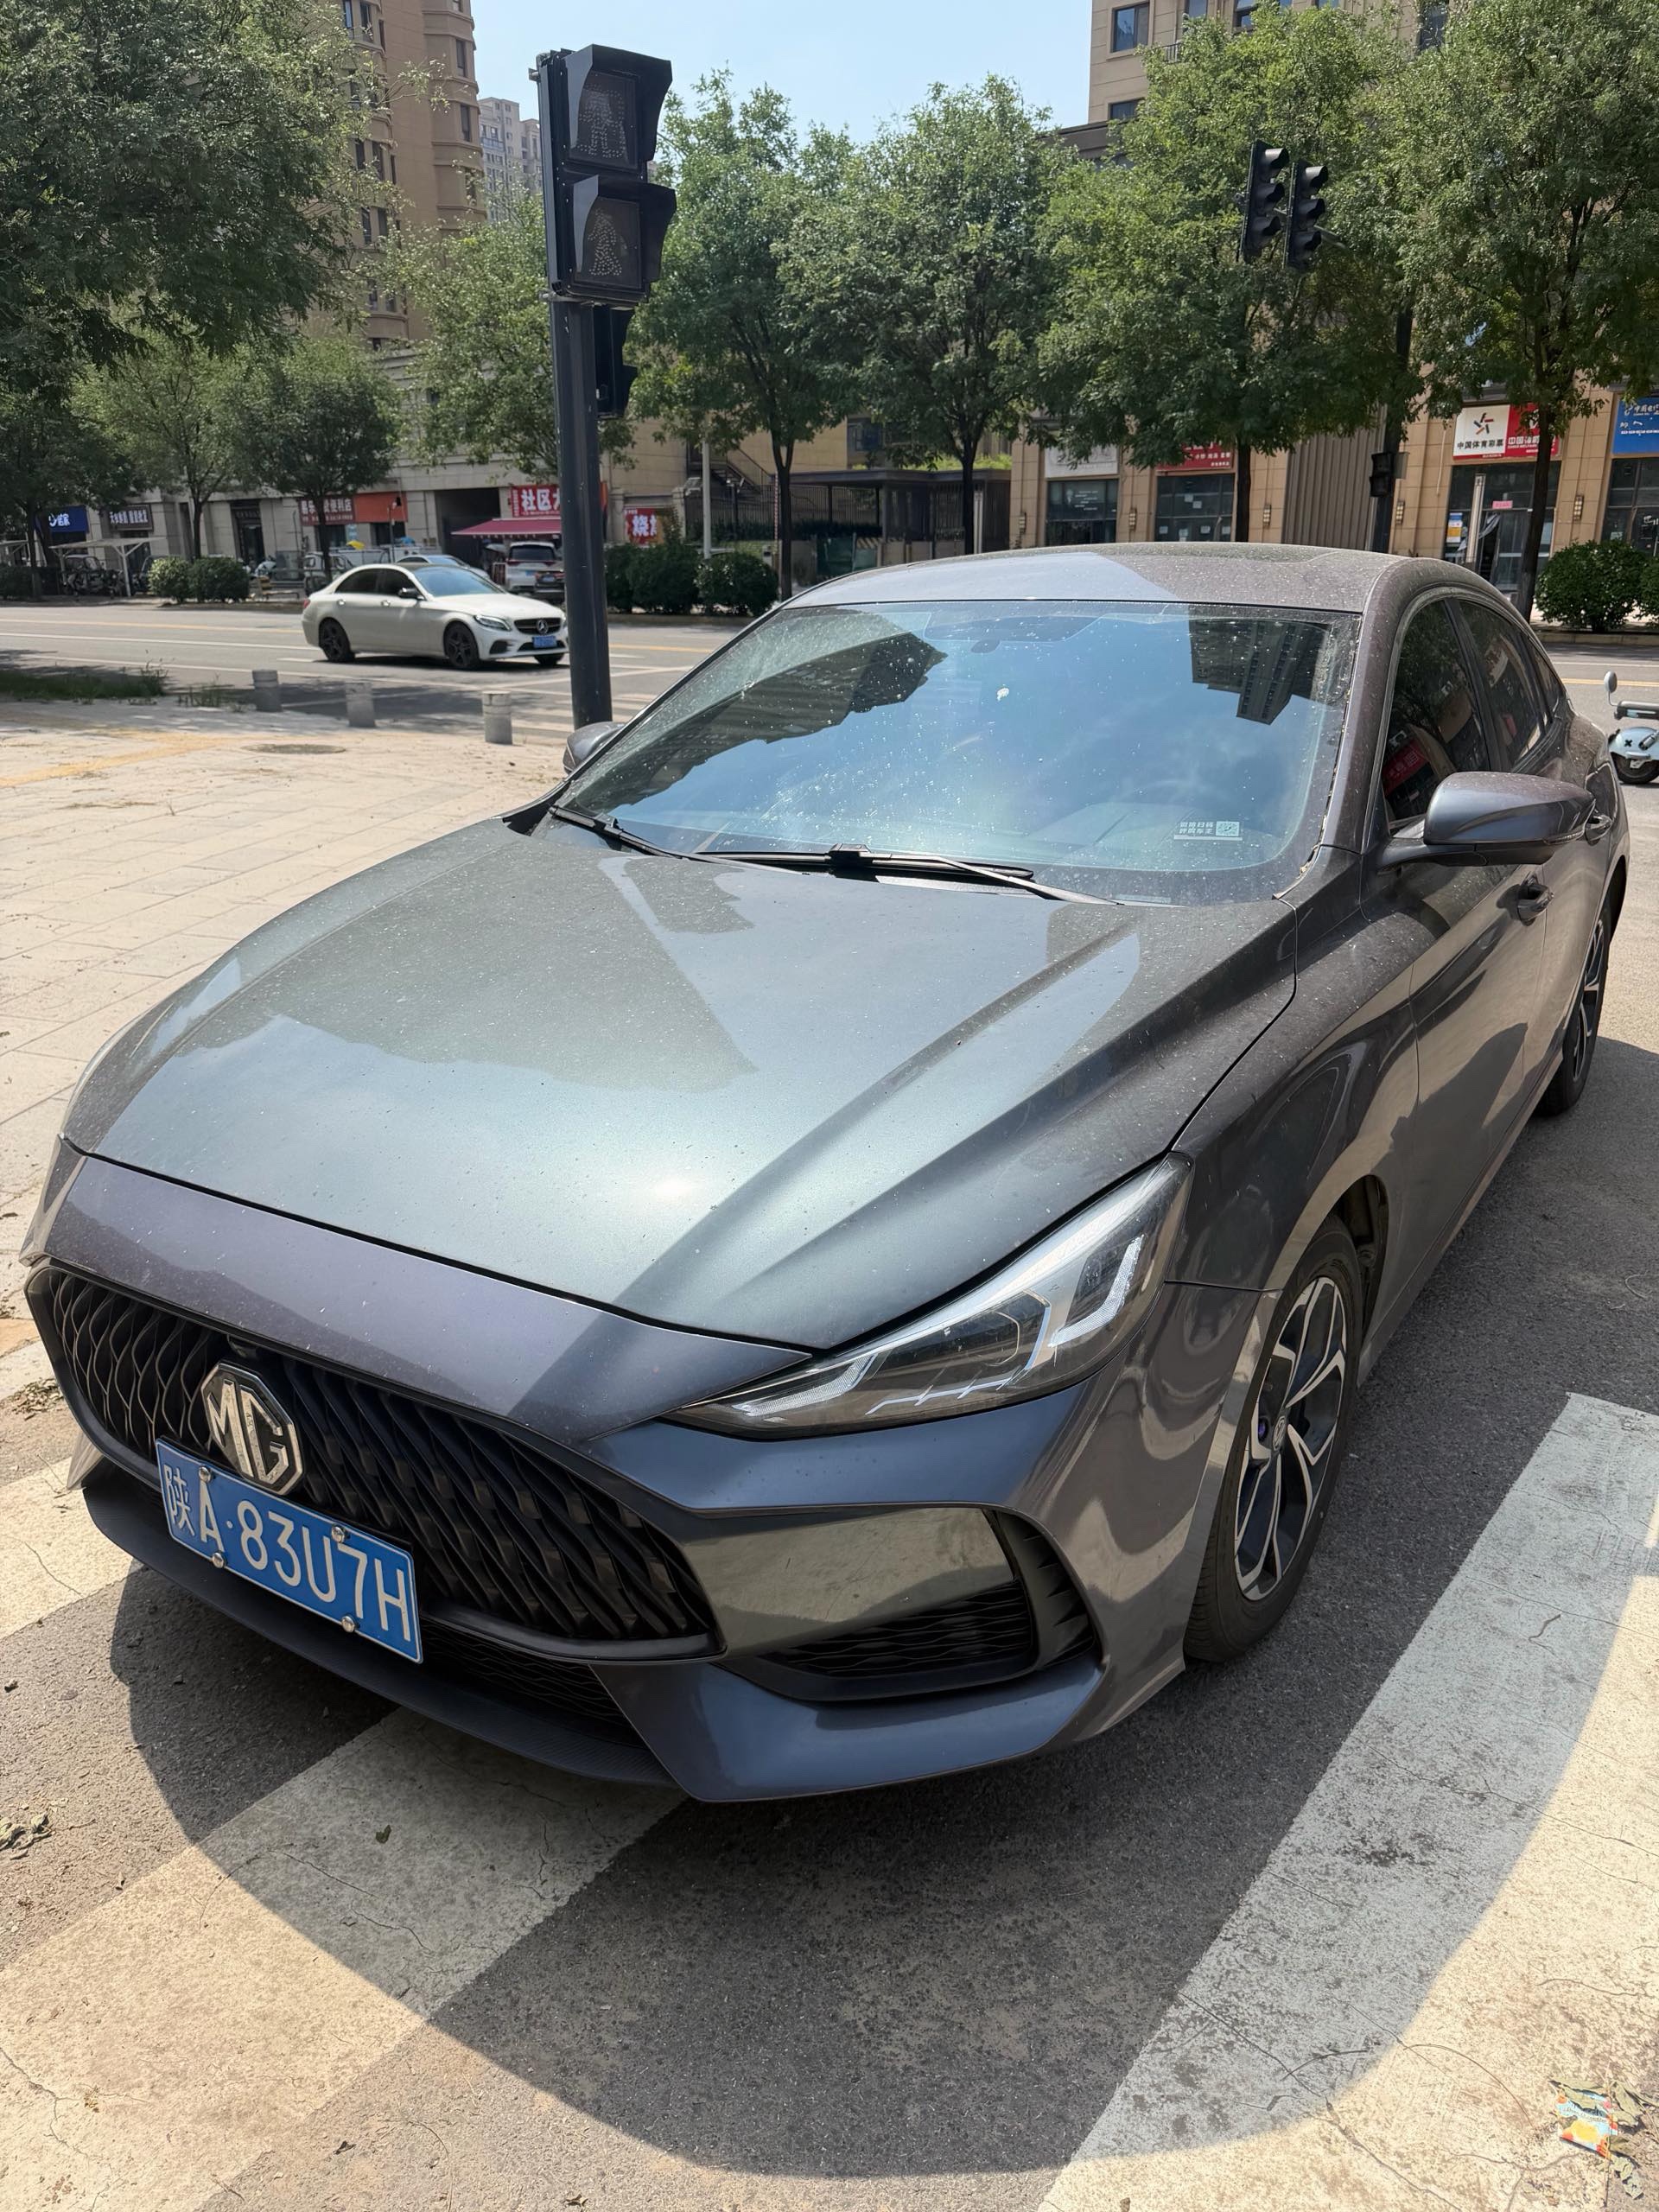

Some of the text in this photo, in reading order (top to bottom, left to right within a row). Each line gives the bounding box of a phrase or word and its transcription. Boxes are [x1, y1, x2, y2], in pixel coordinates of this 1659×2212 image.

[1457, 439, 1503, 449] 中国体育彩票
[207, 1379, 290, 1486] MG
